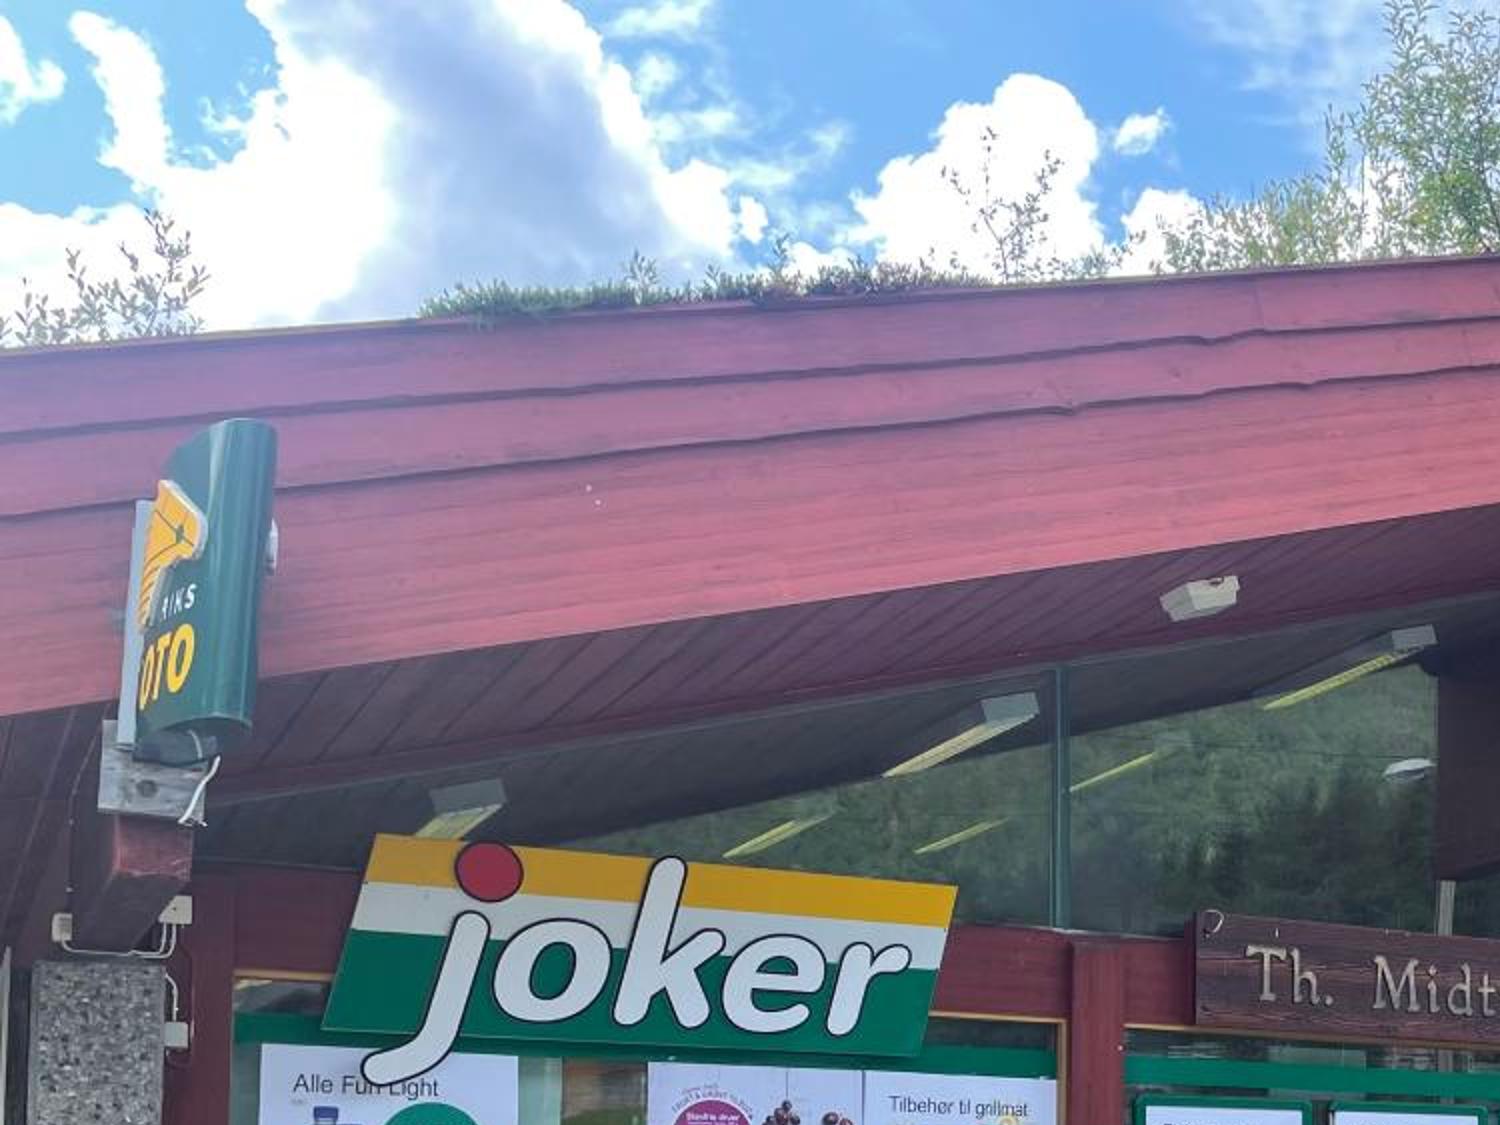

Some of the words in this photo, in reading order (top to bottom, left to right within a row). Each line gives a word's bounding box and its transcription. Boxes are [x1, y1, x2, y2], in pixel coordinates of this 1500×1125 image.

[360, 842, 912, 1087] joker
[1245, 944, 1335, 1006] Th.
[292, 1073, 334, 1095] Alle
[889, 1095, 954, 1116] Tilbehør
